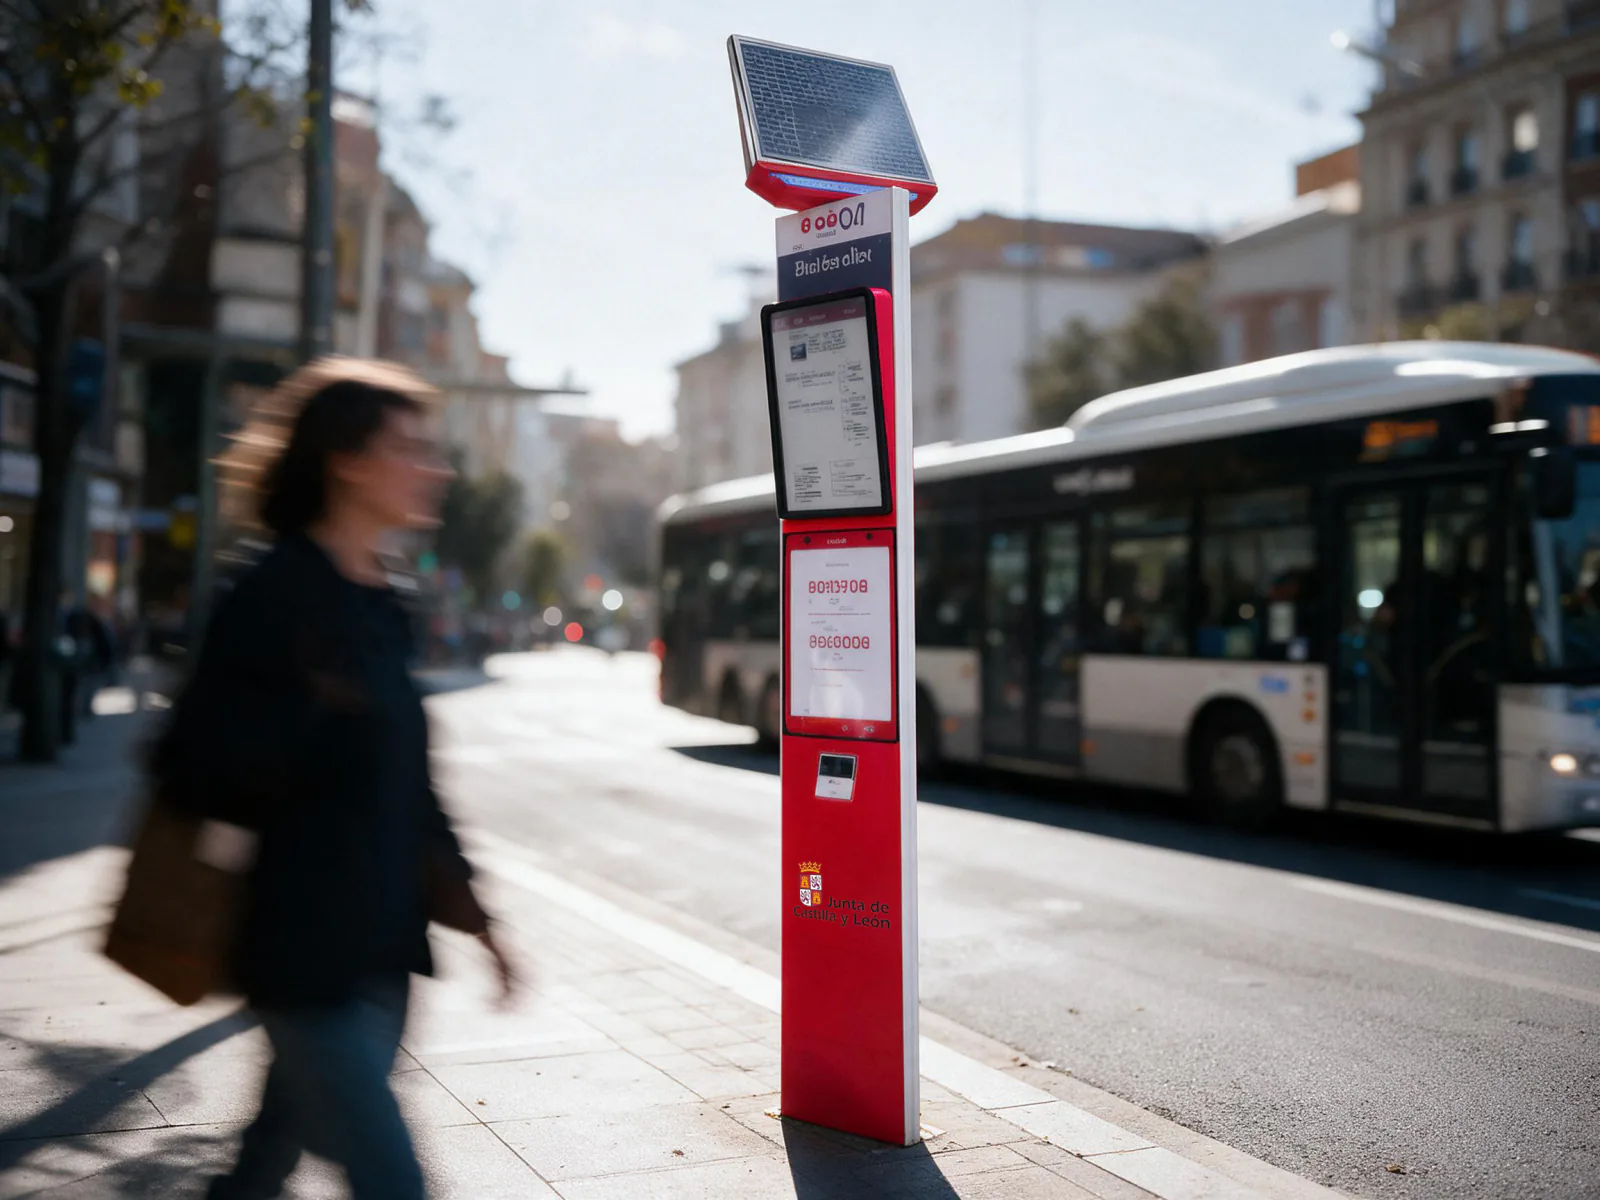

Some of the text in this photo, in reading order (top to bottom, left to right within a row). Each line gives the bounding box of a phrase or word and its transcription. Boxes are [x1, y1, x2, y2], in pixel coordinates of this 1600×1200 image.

[828, 896, 889, 914] Junta de
[793, 906, 891, 929] Castilla y León
